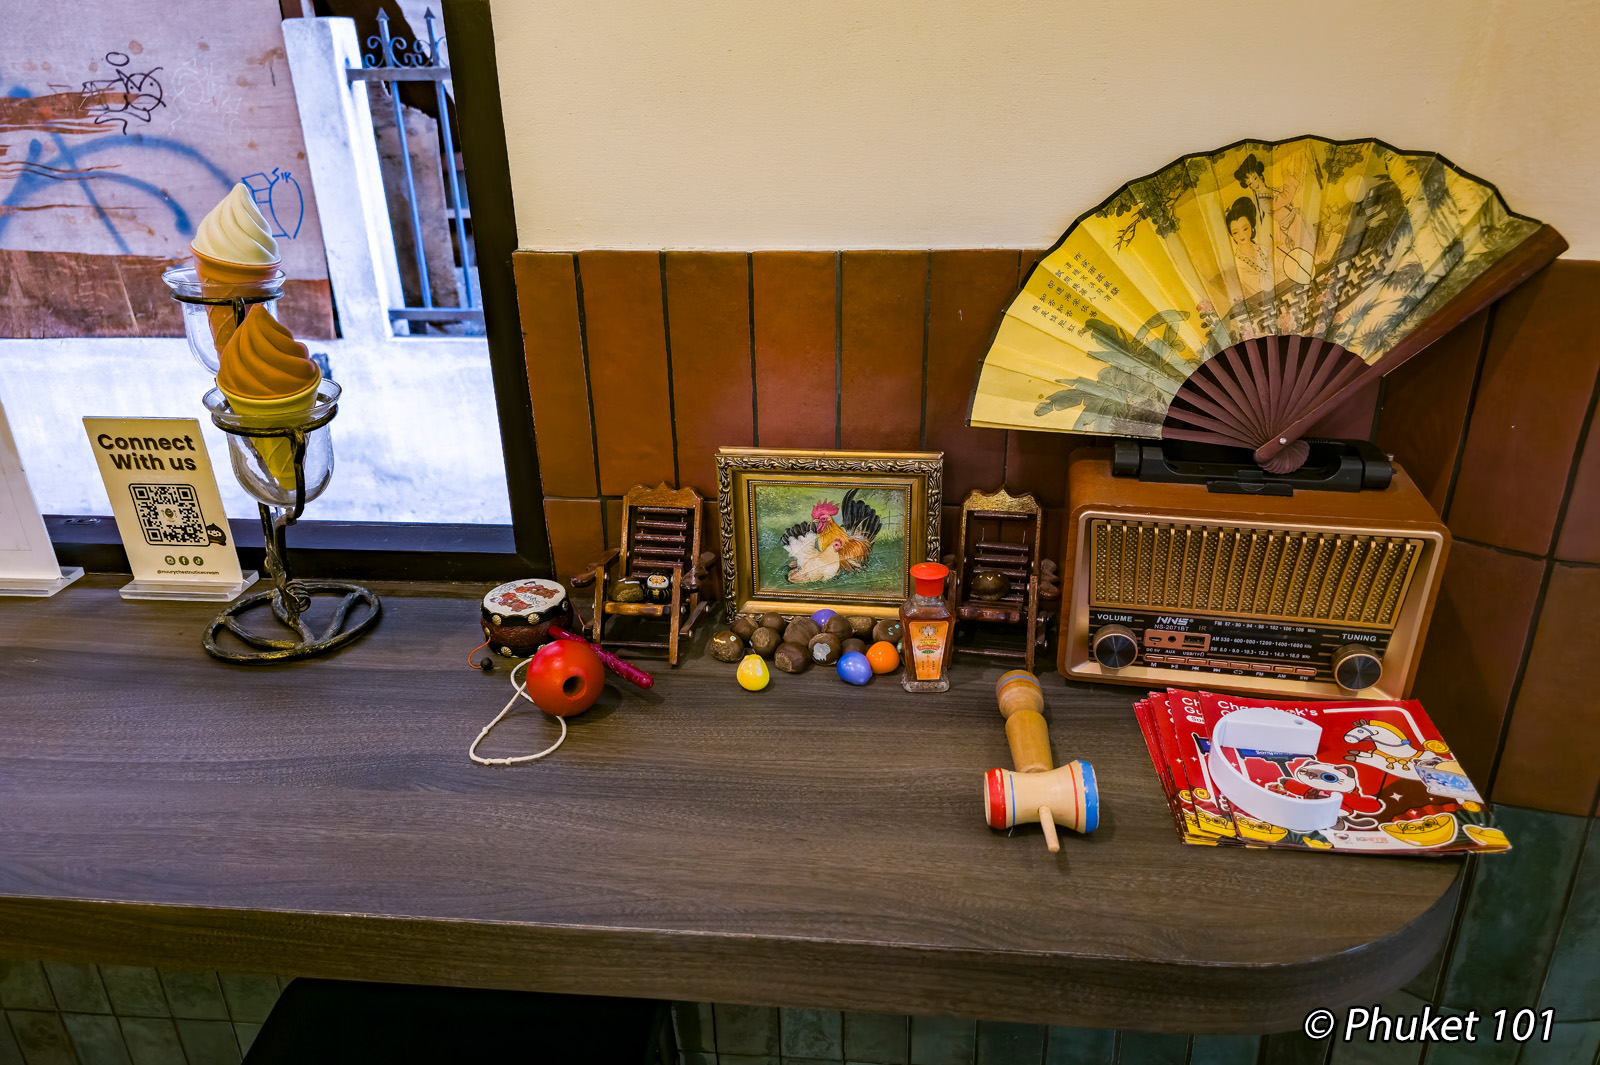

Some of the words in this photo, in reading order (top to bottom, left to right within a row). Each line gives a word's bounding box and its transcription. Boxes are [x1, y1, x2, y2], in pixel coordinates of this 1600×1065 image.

[98, 434, 196, 451] Connect
[109, 452, 166, 470] With
[168, 458, 197, 470] us
[1097, 614, 1133, 622] VOLUME
[1342, 633, 1377, 642] TUNING
